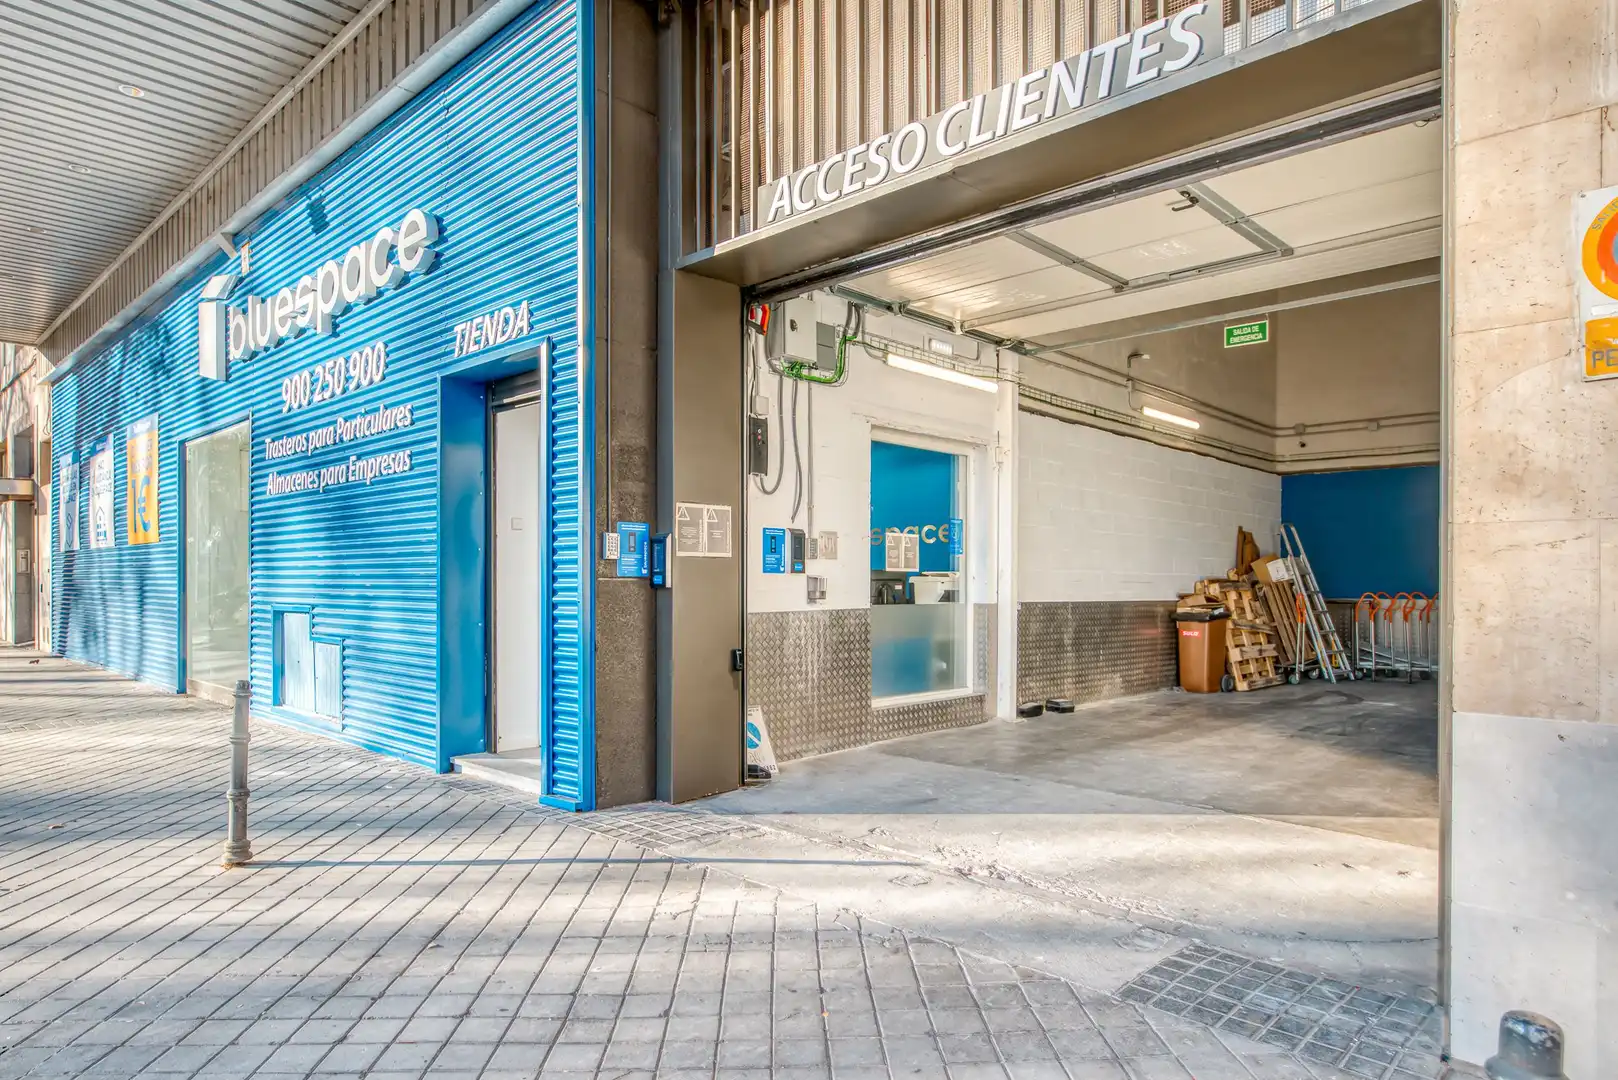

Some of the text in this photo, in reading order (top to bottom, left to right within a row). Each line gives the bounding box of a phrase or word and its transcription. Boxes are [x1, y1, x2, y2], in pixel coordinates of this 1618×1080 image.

[766, 4, 1208, 223] ACCESO CLIENTES
[229, 208, 438, 362] bluespace
[453, 299, 531, 358] TIENDA
[281, 341, 389, 413] 900 250 900
[264, 404, 414, 460] Trasteros para Particulares
[266, 449, 413, 495] Almacenes para Empresas
